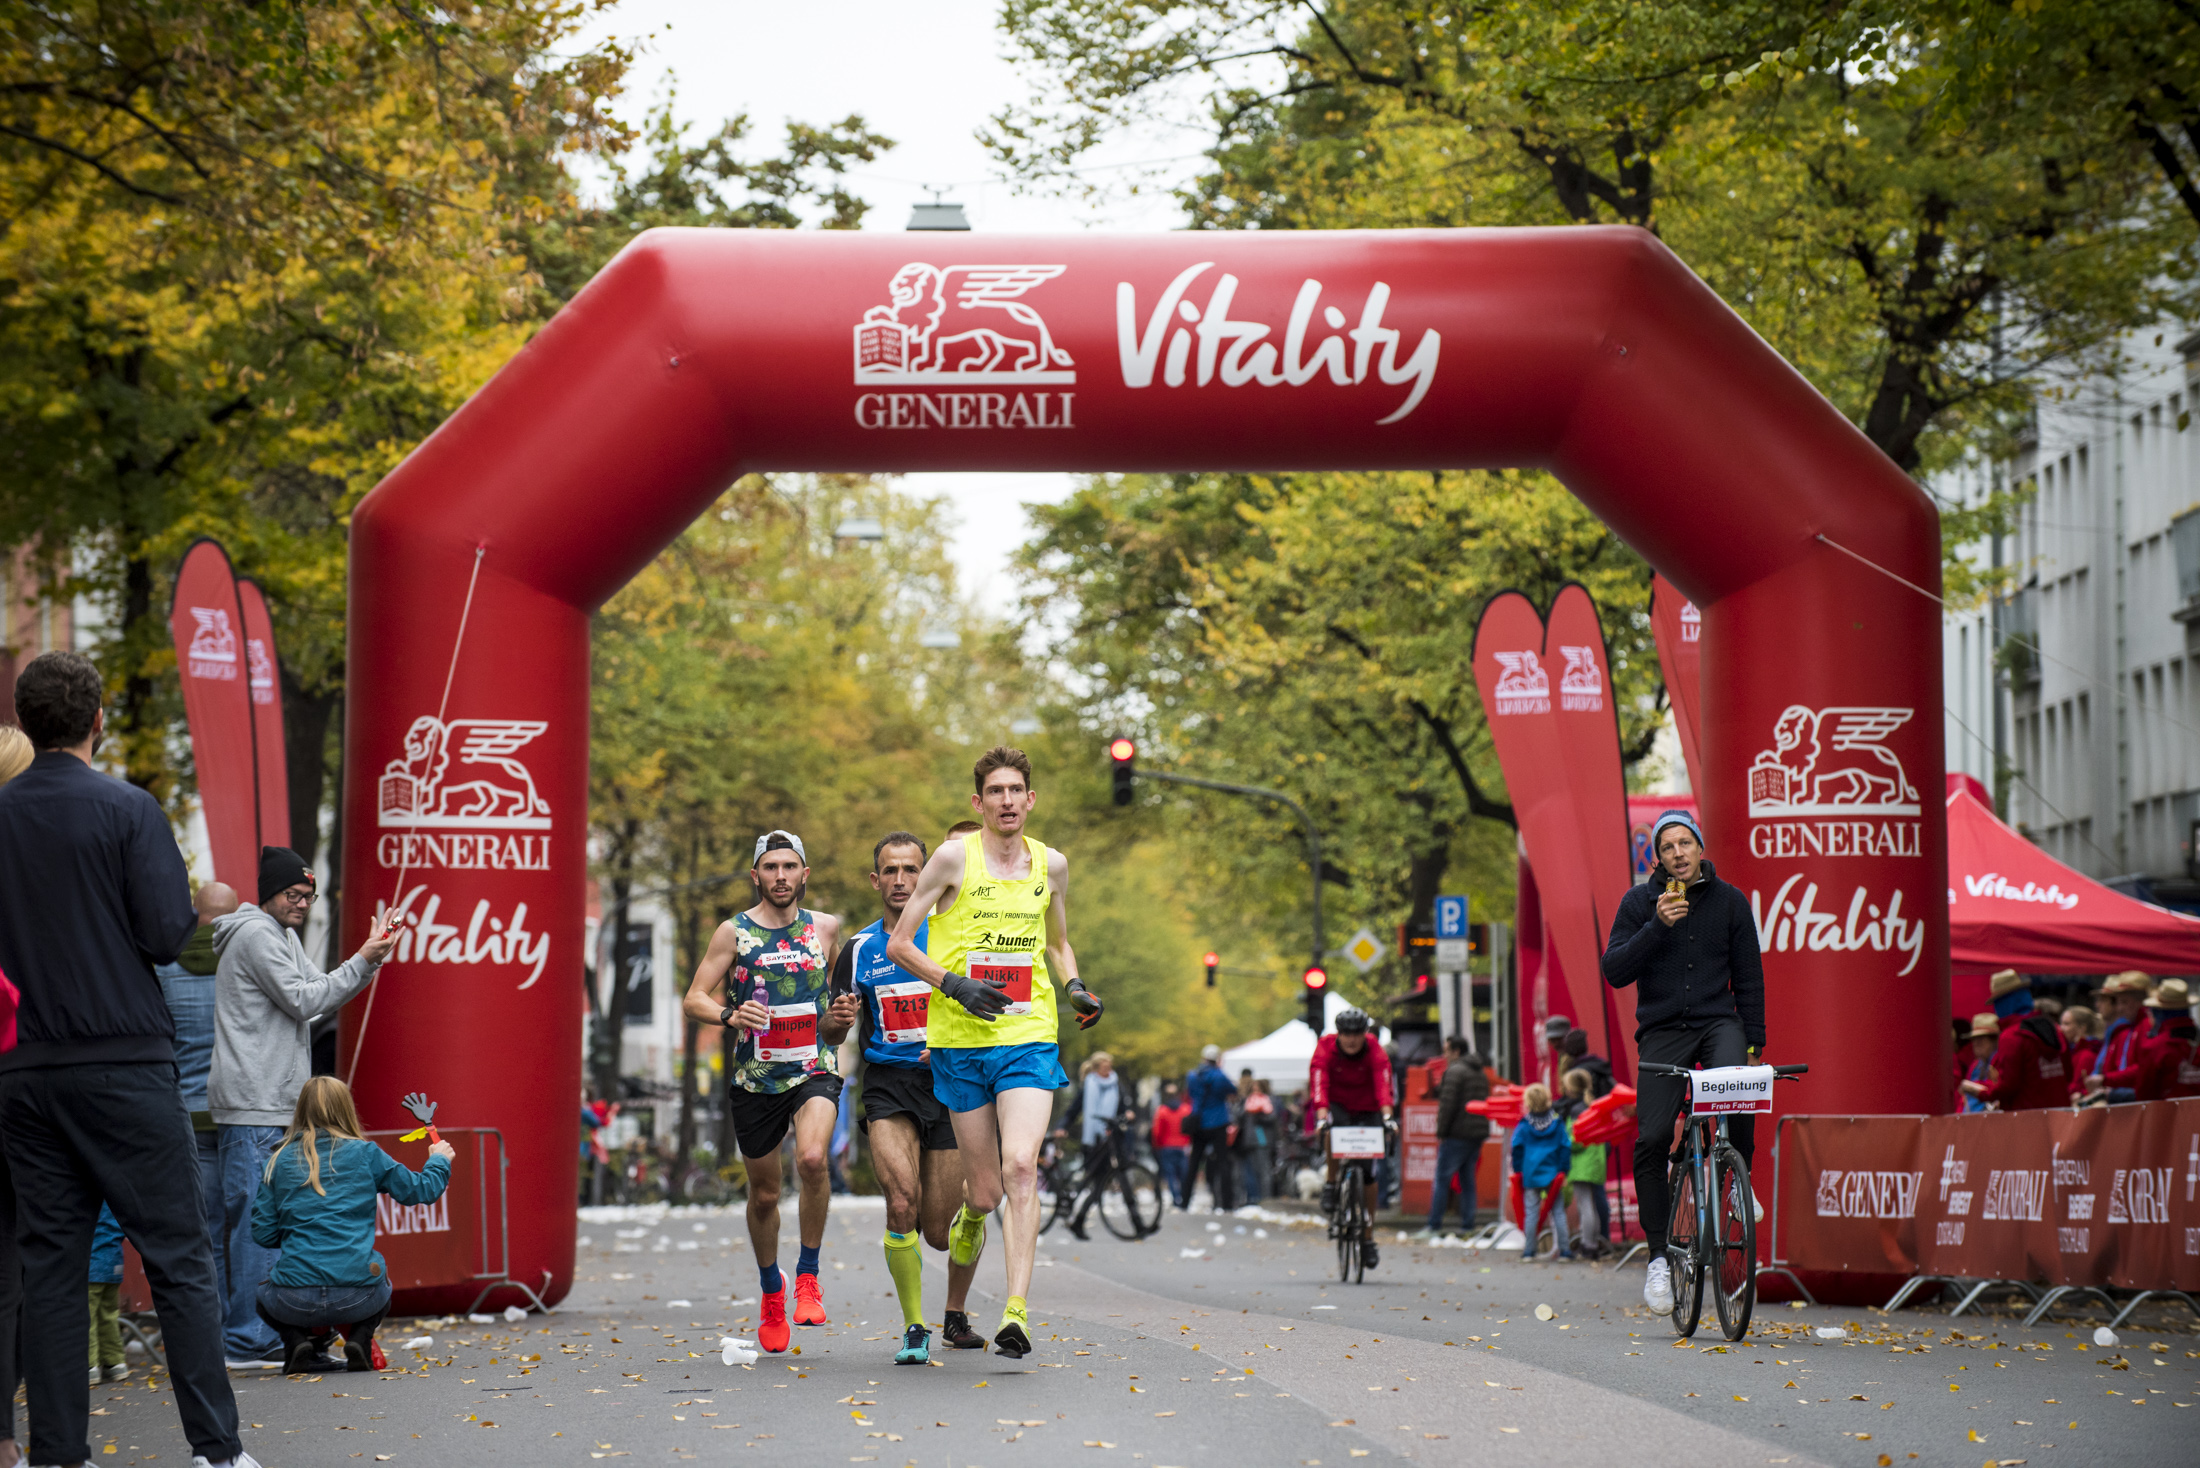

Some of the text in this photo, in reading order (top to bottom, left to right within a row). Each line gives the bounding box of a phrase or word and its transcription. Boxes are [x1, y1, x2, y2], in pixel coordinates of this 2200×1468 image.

[1116, 261, 1441, 425] Vitality
[854, 392, 1076, 429] GENERALI
[1749, 821, 1922, 858] GENERALI
[377, 833, 551, 870] GENERALI
[1964, 872, 2079, 910] Vitality
[1751, 873, 1924, 976] Vitality
[996, 933, 1037, 948] bunert
[765, 953, 798, 961] SAYSKY
[872, 962, 896, 976] bunert
[984, 969, 1019, 982] Nikki
[892, 997, 928, 1013] 7213
[770, 1020, 813, 1033] hilippe
[785, 1038, 790, 1046] 8
[1701, 1081, 1767, 1094] Begleitung
[1732, 1102, 1756, 1110] Fahrt!
[375, 1188, 450, 1236] NERALI
